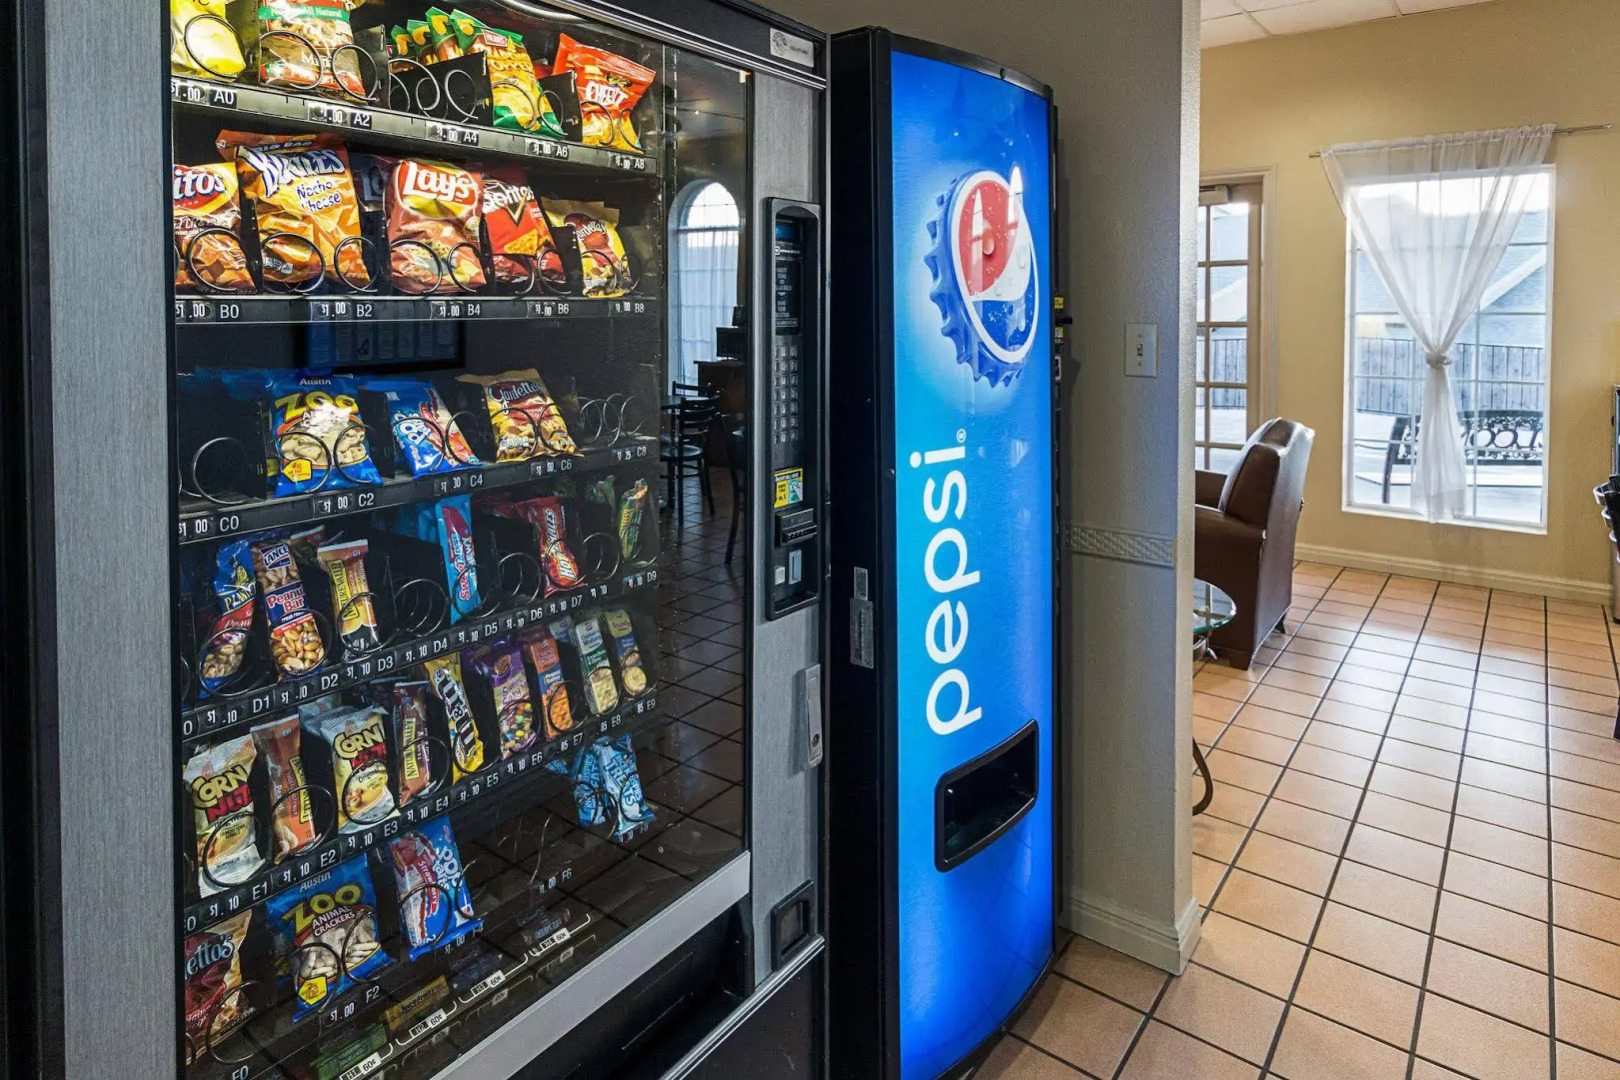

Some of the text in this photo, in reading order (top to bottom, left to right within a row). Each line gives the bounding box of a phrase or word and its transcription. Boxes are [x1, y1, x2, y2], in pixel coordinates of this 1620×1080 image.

[316, 7, 342, 18] Natural
[213, 90, 235, 105] A0
[353, 112, 371, 126] A2
[463, 130, 479, 144] A4
[556, 145, 569, 158] A6
[634, 158, 645, 170] A8
[174, 168, 226, 200] itos
[296, 180, 333, 199] Nacho
[219, 304, 239, 319] B0
[356, 304, 373, 318] B2
[467, 303, 481, 317] B4
[557, 303, 569, 316] B6
[634, 302, 645, 314] B8
[299, 378, 332, 386] Austin
[274, 390, 360, 424] ZOO
[636, 447, 647, 458] C8
[561, 459, 572, 472] C6
[470, 474, 484, 488] C4
[358, 493, 375, 507] C2
[219, 515, 240, 532] C0
[263, 546, 289, 566] LANCE
[461, 536, 477, 576] CEWY
[557, 552, 579, 581] HOT
[647, 570, 657, 583] D9
[909, 445, 983, 737] pepsi
[283, 597, 305, 614] Bar
[571, 595, 583, 608] D7
[530, 607, 543, 621] D6
[484, 622, 498, 637] D5
[405, 638, 449, 662] $1.10 D4
[377, 655, 395, 673] D3
[320, 673, 339, 691] D2
[206, 697, 271, 725] $1.10 D1
[647, 698, 657, 711] E9
[183, 719, 193, 736] 0
[611, 715, 622, 728] E8
[333, 723, 386, 760] CORN
[572, 732, 583, 746] E7
[531, 752, 543, 767] E6
[191, 764, 249, 810] CORN
[486, 772, 499, 788] E5
[603, 754, 636, 807] TRETS
[275, 784, 285, 811] Peaut
[436, 795, 449, 812] E4
[384, 820, 399, 837] E3
[320, 849, 337, 868] E2
[300, 870, 332, 892] Austin
[562, 868, 572, 884] F6
[209, 882, 268, 917] $1.10 E1
[281, 883, 364, 934] ZOO
[183, 916, 196, 931] 0
[312, 905, 351, 929] ANIMAL
[314, 911, 356, 938] CRACKERS
[185, 934, 235, 977] etto's
[490, 974, 502, 986] 60¢
[366, 985, 380, 1003] F2
[430, 1013, 443, 1026] 60¢
[362, 1059, 377, 1073] 60¢
